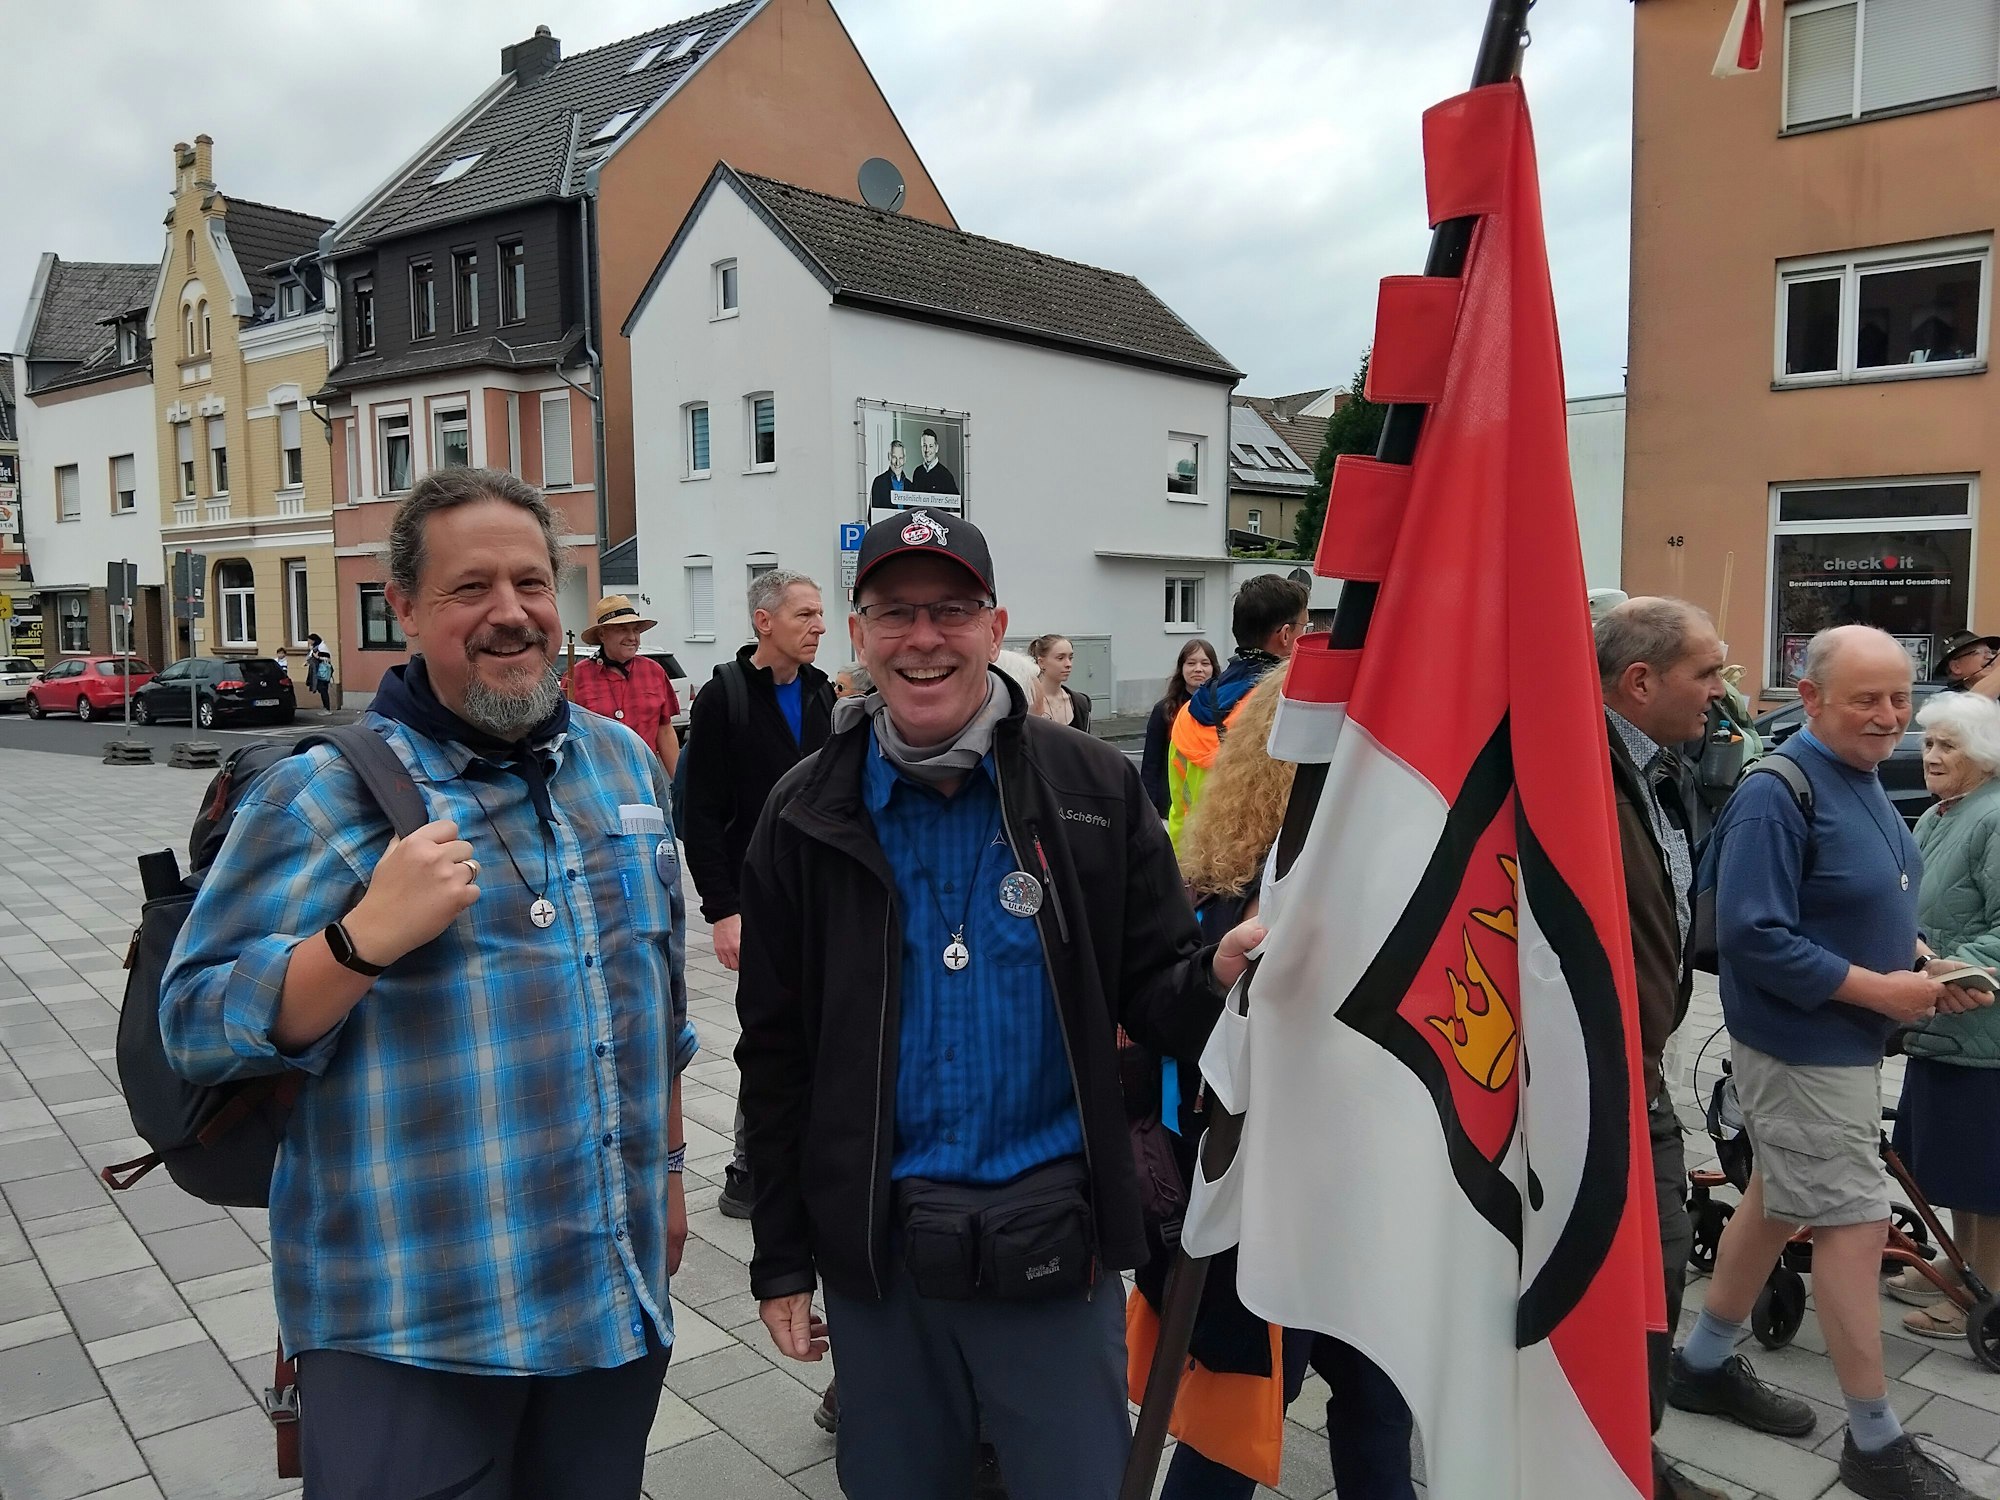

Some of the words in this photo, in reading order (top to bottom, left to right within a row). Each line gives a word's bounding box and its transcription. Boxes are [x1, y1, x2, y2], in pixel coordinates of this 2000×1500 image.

[894, 493, 922, 503] Persönlich
[846, 527, 860, 548] P
[1667, 535, 1684, 547] 48
[1823, 557, 1881, 571] check
[1900, 555, 1914, 569] it
[1789, 580, 1847, 588] Beratungsstelle
[1848, 578, 1888, 586] Sexualität
[1889, 578, 1904, 586] und
[1905, 577, 1951, 586] Gesundheit
[640, 593, 651, 605] 46
[1066, 809, 1110, 828] Schöffel
[1008, 902, 1035, 914] ULRICH
